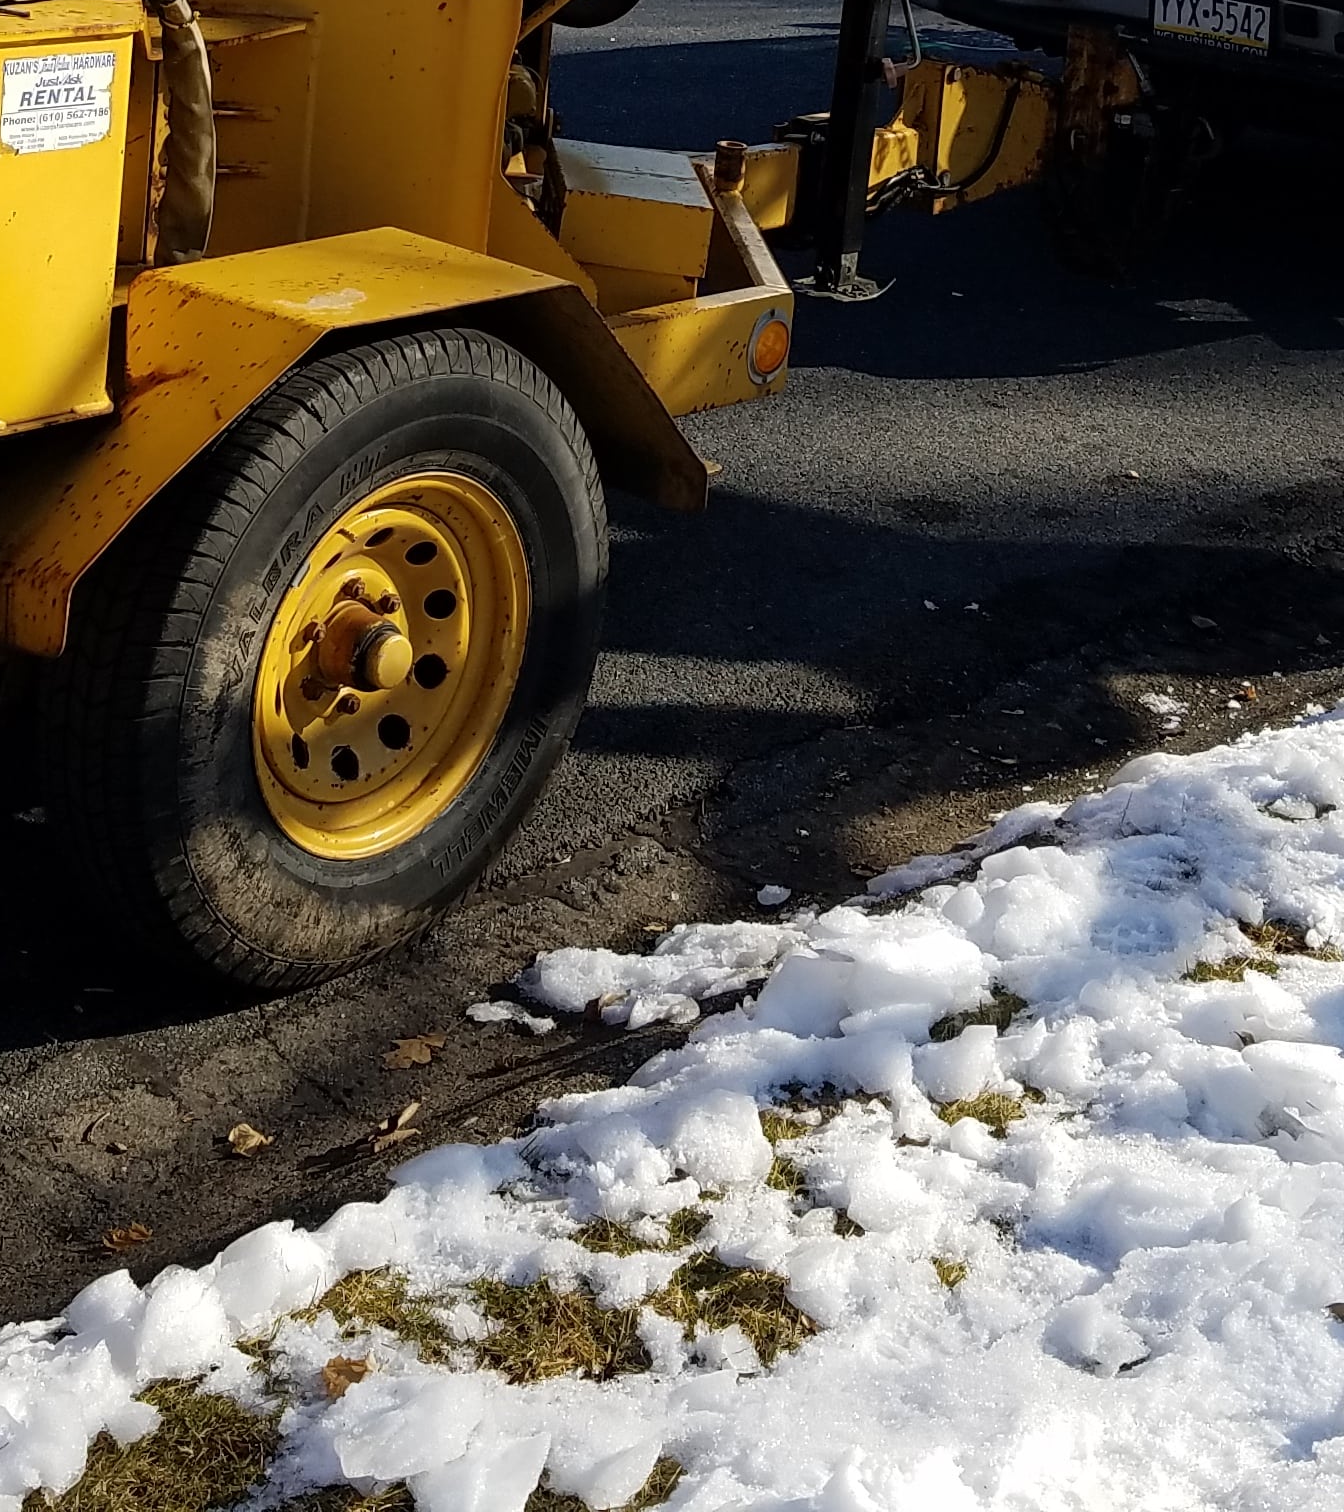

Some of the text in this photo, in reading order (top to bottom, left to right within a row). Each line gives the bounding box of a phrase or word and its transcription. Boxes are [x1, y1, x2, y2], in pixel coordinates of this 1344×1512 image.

[4, 59, 40, 76] KUZAN'S
[73, 54, 116, 70] HARDWARE
[19, 85, 97, 107] RENTAL
[2, 115, 36, 126] Phone:
[39, 111, 64, 124] (610)
